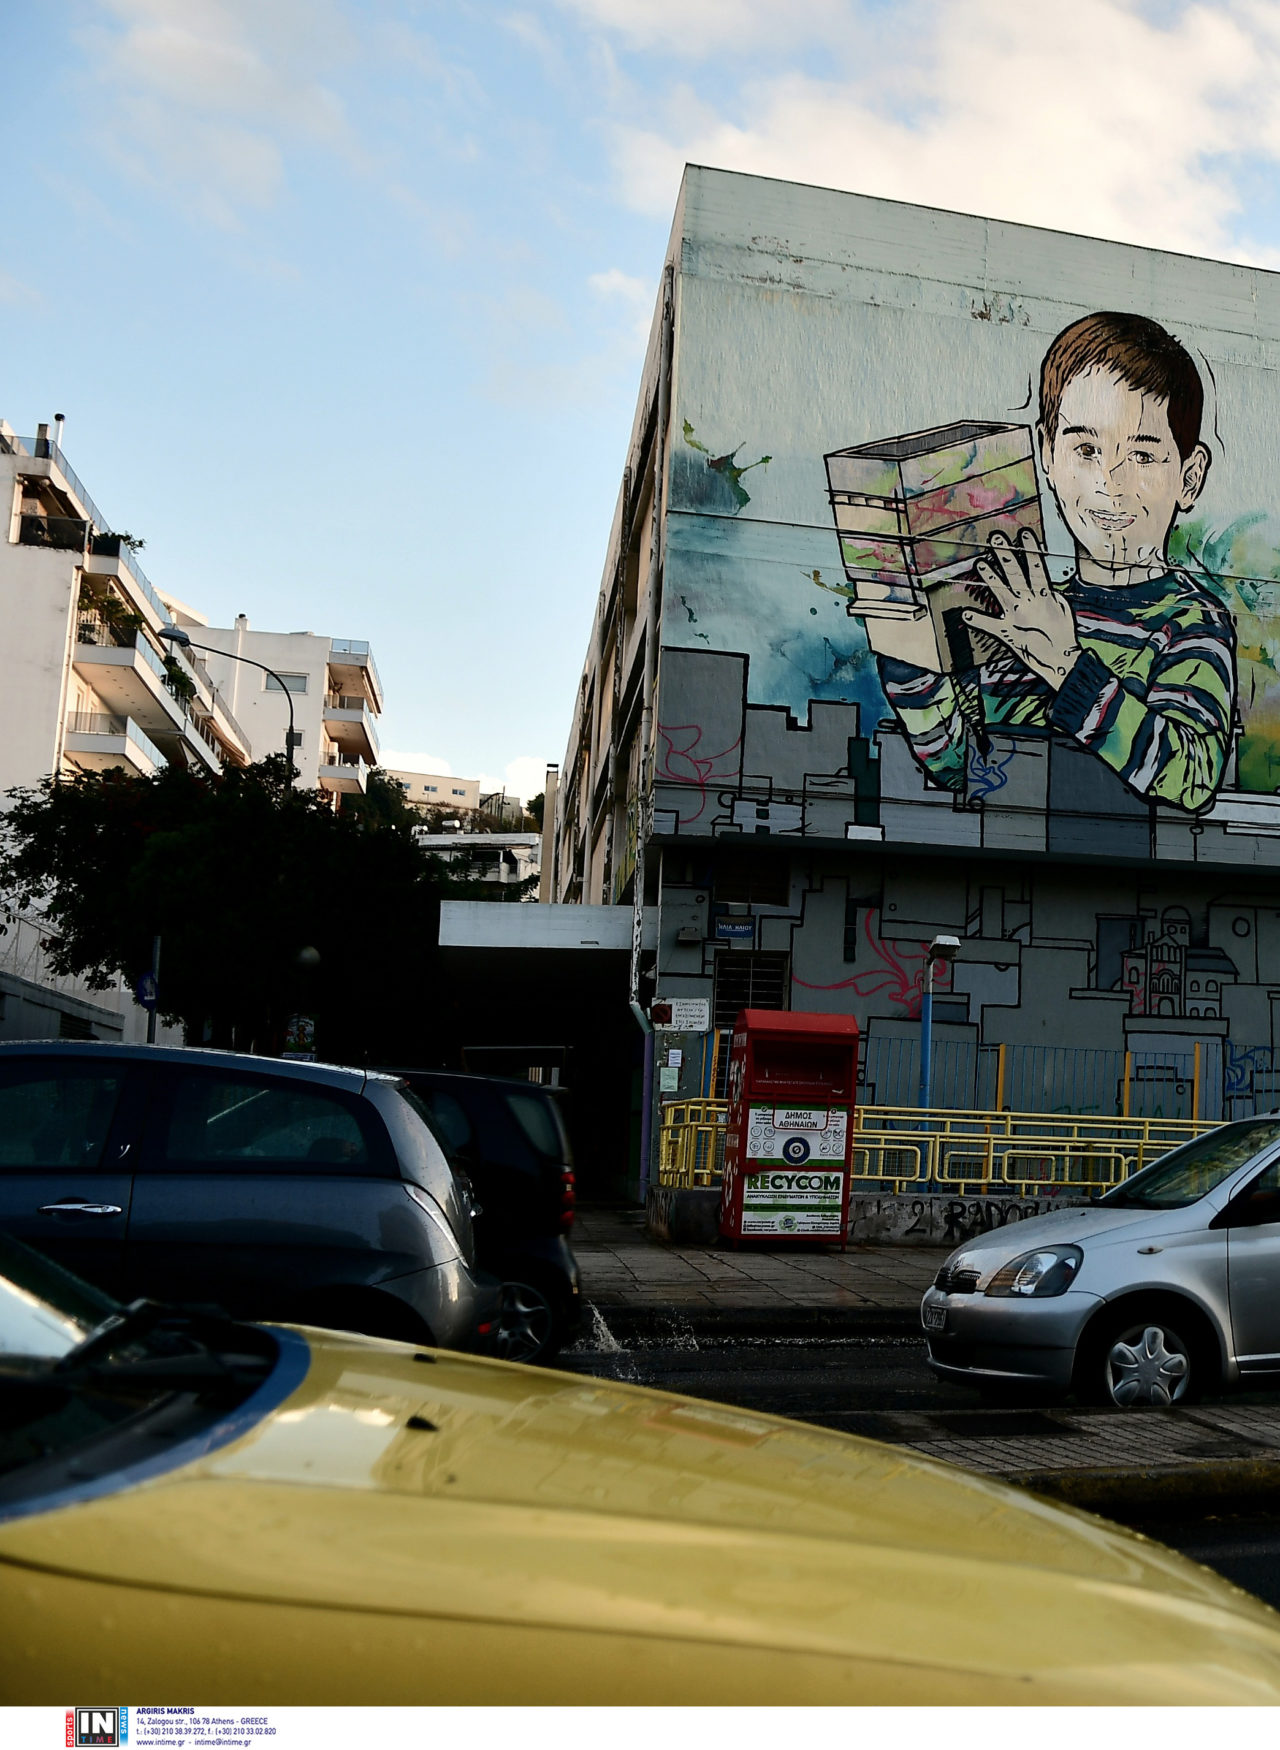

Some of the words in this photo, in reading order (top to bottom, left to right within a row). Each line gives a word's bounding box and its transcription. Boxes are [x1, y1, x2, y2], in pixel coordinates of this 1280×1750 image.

[785, 1112, 813, 1120] ΔΗΜΟΣ
[779, 1120, 818, 1128] ΑΘΗΝΑΙΩΝ
[747, 1174, 840, 1191] RECYCOM
